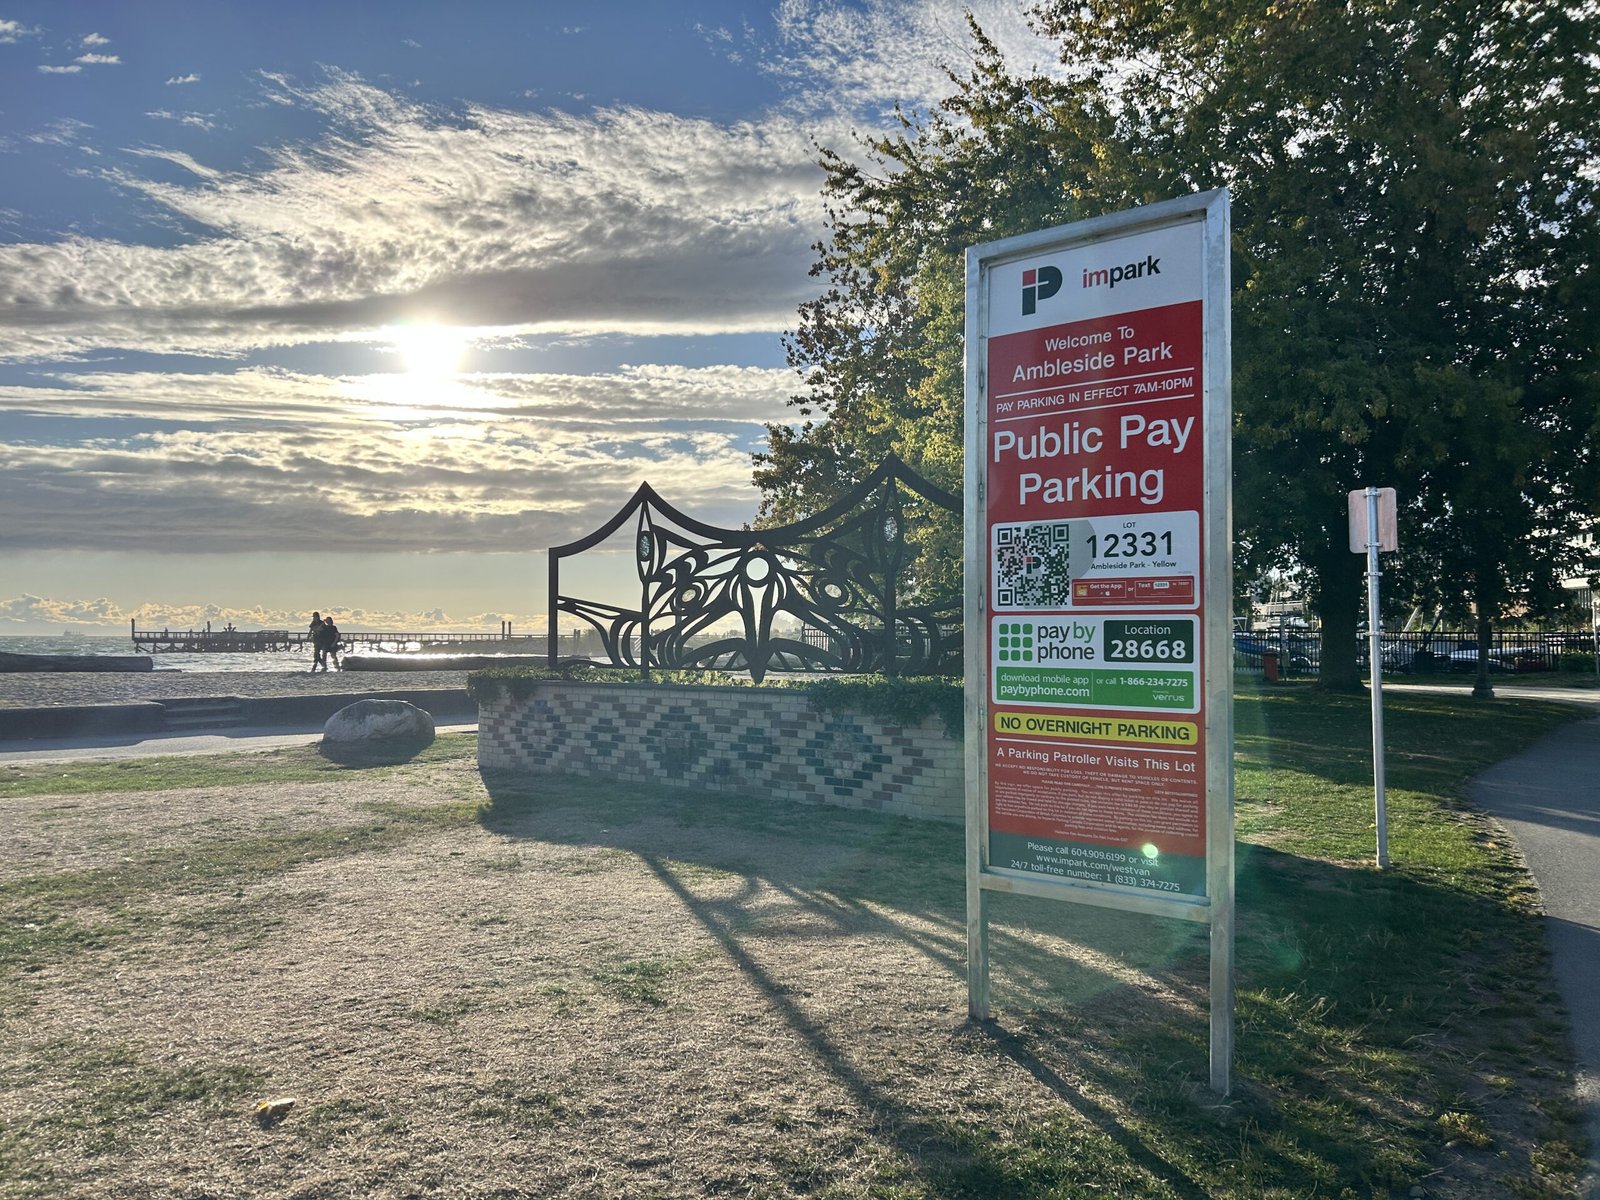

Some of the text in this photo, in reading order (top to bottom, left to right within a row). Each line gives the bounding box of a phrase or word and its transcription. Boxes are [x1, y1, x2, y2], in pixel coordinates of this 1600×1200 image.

[1083, 255, 1161, 288] impark
[1045, 325, 1134, 352] Welcome To
[1013, 342, 1173, 383] Ambleside Park
[996, 377, 1193, 413] PAY PARKING IN EFFECT 7AM-10PM
[994, 414, 1195, 463] Public Pay
[1019, 465, 1164, 505] Parking
[1086, 531, 1172, 559] 12331
[1152, 560, 1177, 568] Yellow
[1037, 621, 1096, 643] pay by
[1124, 625, 1171, 635] Location
[1037, 641, 1095, 663] phone
[1111, 640, 1186, 659] 28668
[1000, 684, 1090, 698] paybyphone.com
[1001, 673, 1089, 685] download mobile app
[1105, 677, 1117, 685] call
[1120, 677, 1188, 687] 1-866-234-7275
[1152, 693, 1185, 702] verrus
[1000, 716, 1190, 741] NO OVERNIGHT PARKING
[996, 747, 1196, 773] A Parking Patroller Visits This Lot
[1027, 841, 1158, 867] Please call 604.909.6199 or visit
[1036, 853, 1150, 876] www.impark.com/westvan
[1010, 859, 1180, 892] 24/7 toll-free number: 1 (833) 374-7275
